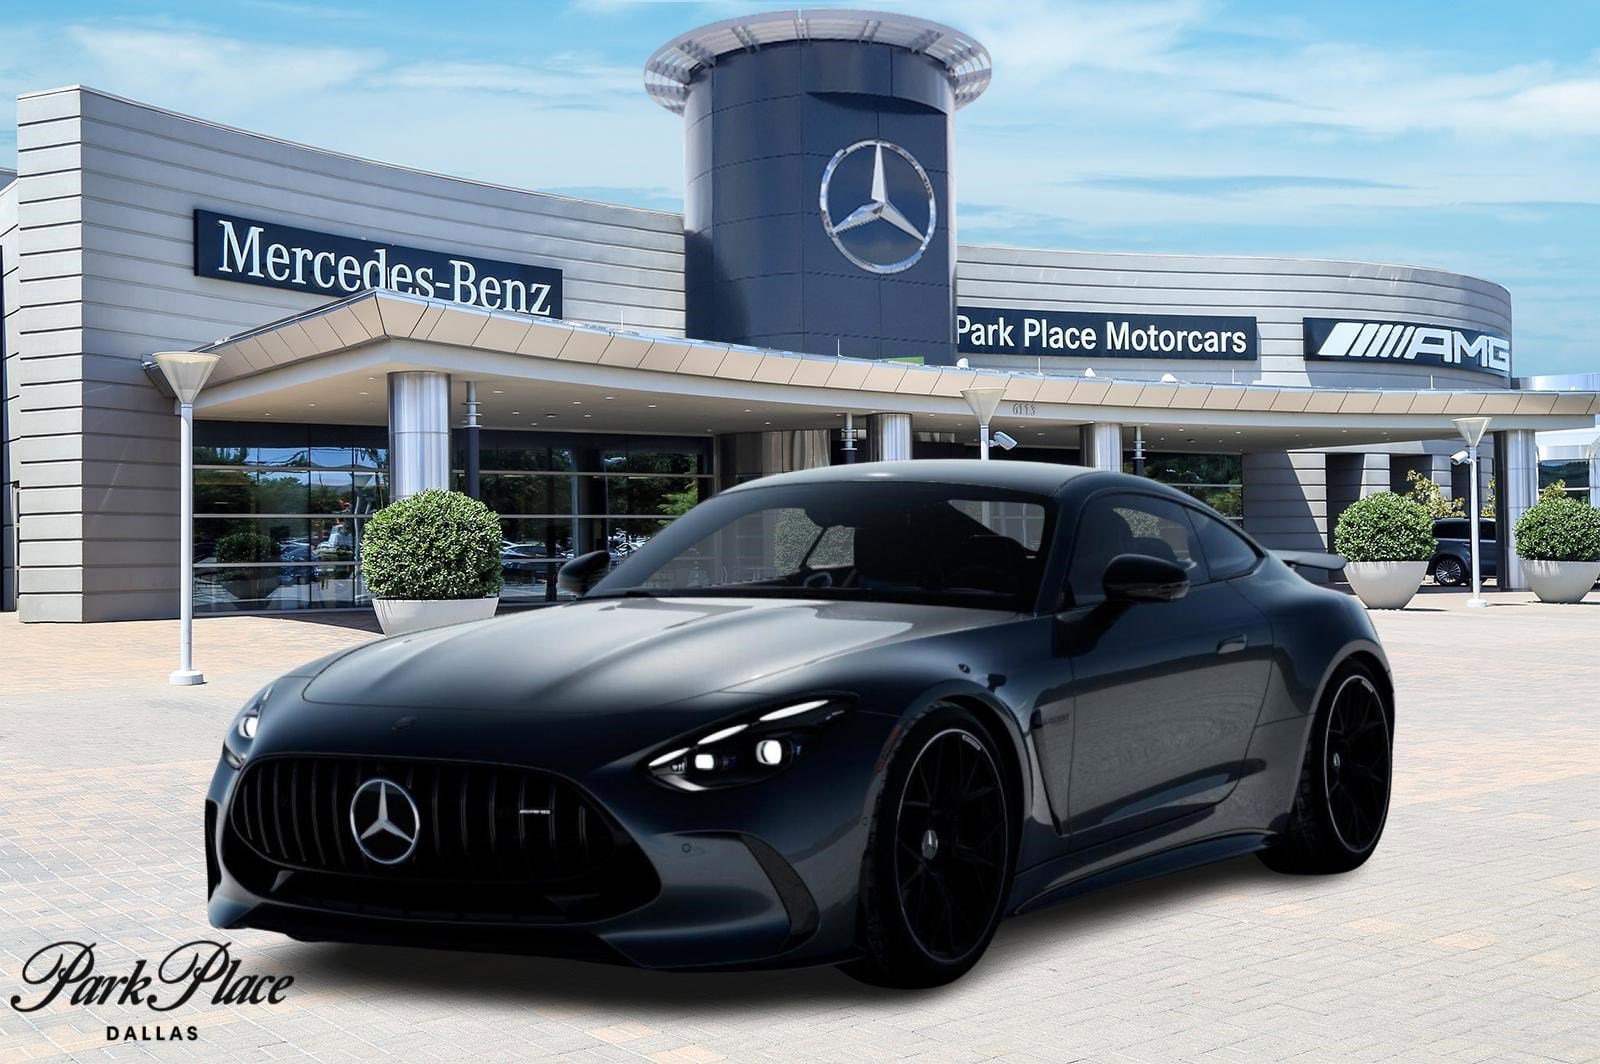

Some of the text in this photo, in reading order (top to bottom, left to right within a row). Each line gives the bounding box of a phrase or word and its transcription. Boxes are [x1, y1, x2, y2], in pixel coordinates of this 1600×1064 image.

[217, 219, 552, 317] Mercedes-Benz
[957, 315, 1247, 354] Park Place Motorcars
[1403, 326, 1510, 373] AMG
[1012, 402, 1036, 417] 6113
